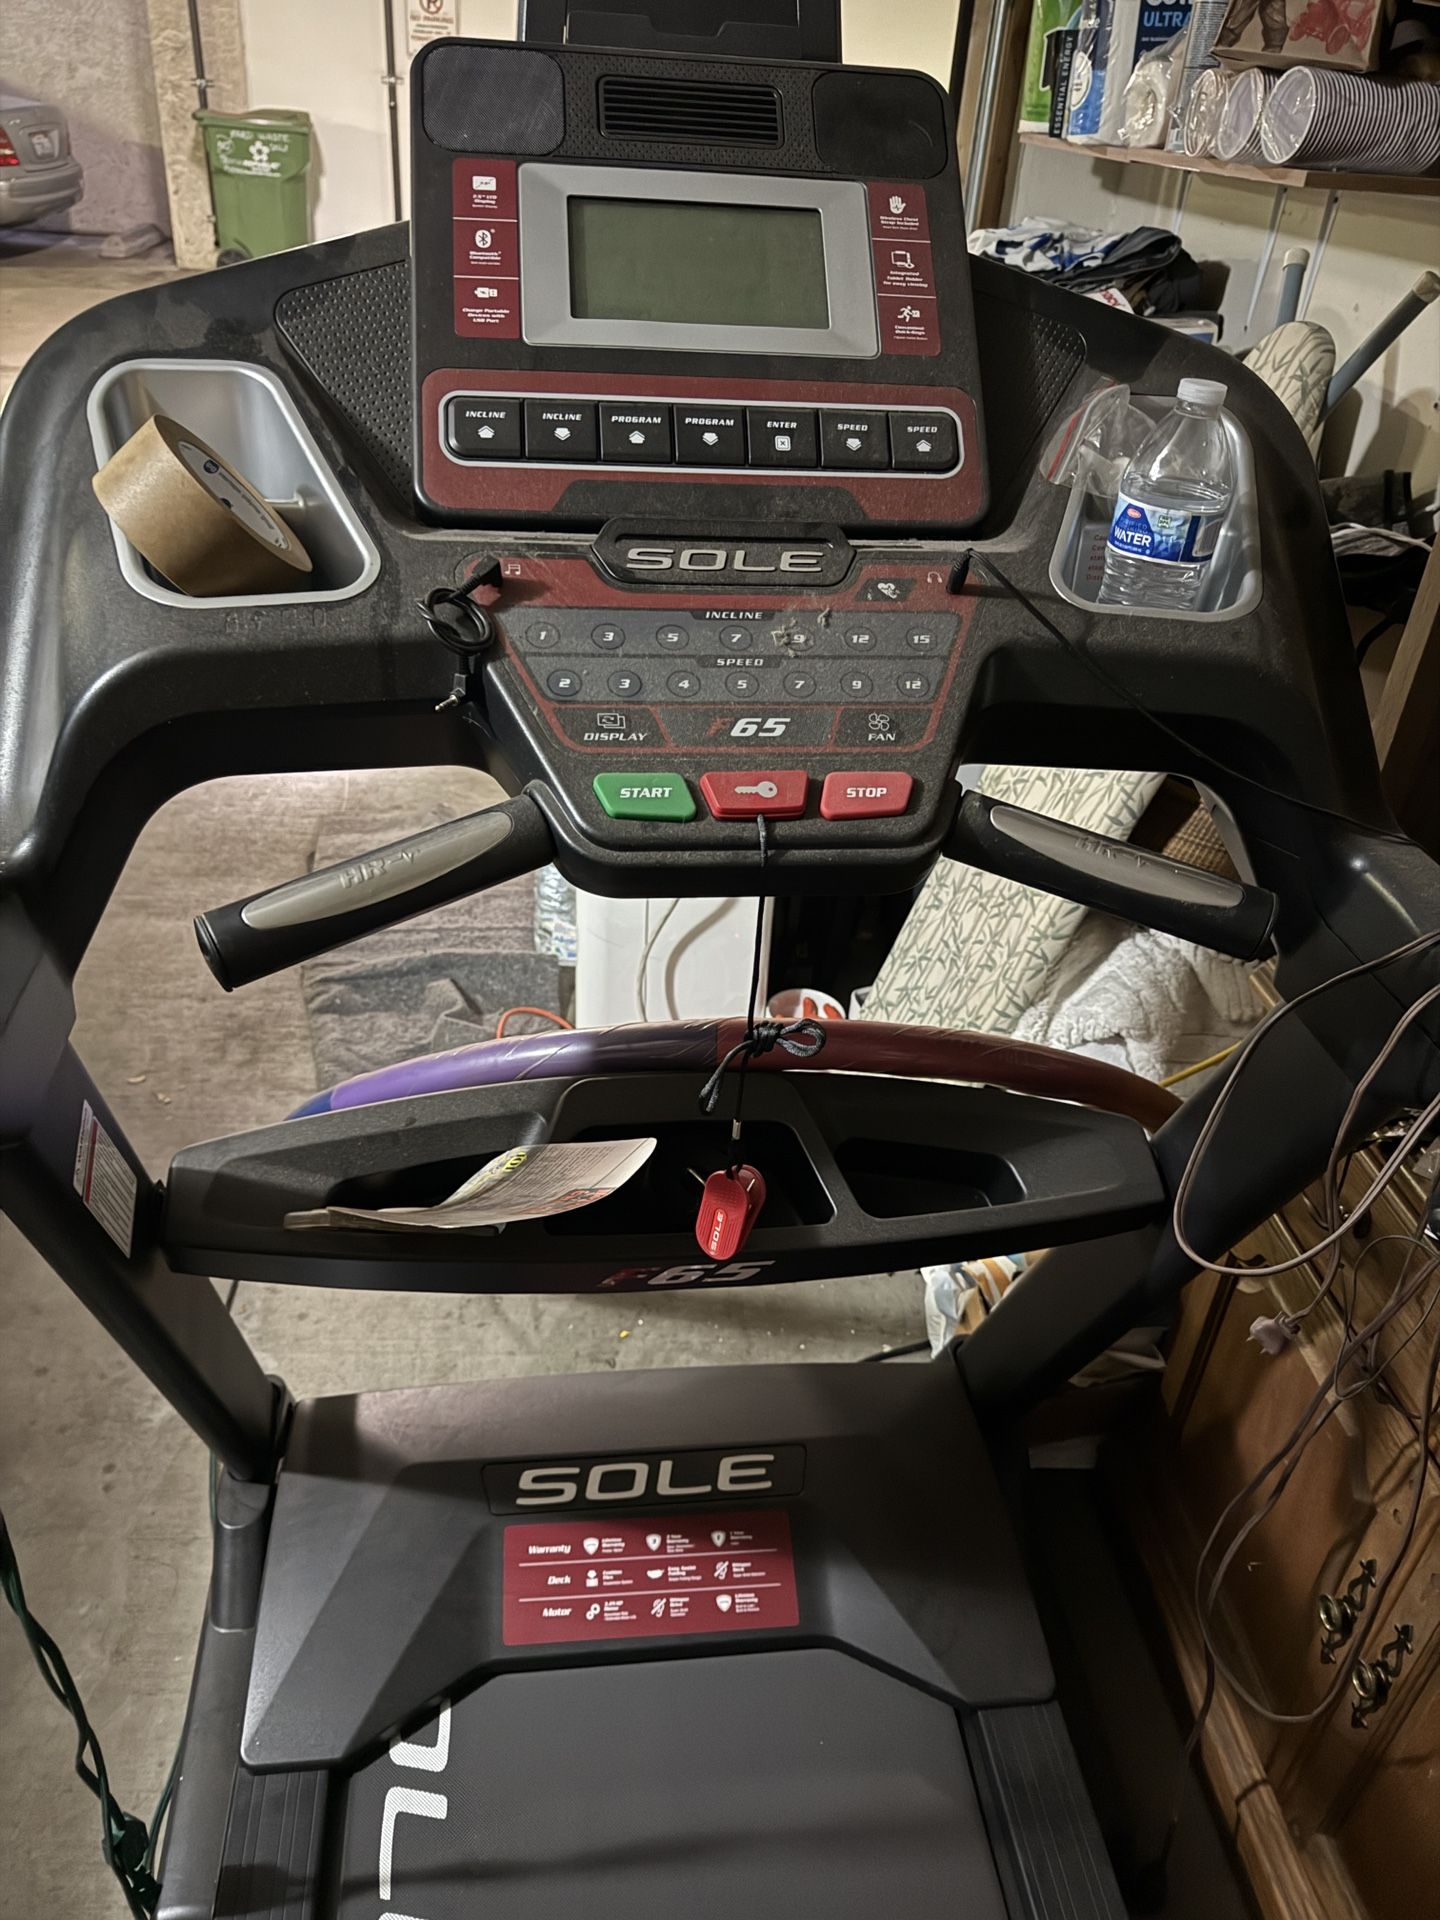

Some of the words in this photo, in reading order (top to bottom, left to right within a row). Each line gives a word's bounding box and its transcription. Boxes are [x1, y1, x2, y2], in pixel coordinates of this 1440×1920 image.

[1053, 80, 1068, 135] ESSENTIAL
[1061, 36, 1074, 77] ENERGY
[465, 410, 506, 419] INCLINE
[542, 412, 582, 421] INCLINE
[611, 415, 662, 424] PROGRAM
[685, 417, 735, 427] PROGRAM
[766, 421, 797, 429] ENTER
[837, 423, 868, 432] SPEED
[907, 425, 938, 433] SPEED
[1114, 526, 1152, 547] WATER
[626, 547, 824, 573] SOLE
[705, 611, 763, 620] INCLINE
[539, 631, 547, 640] 1
[602, 632, 615, 641] 3
[666, 632, 679, 642] 5
[730, 633, 742, 643] 7
[793, 634, 806, 643] 9
[852, 634, 870, 644] 12
[912, 634, 931, 644] 15
[716, 658, 764, 667] SPEED
[558, 678, 571, 688] 2
[618, 679, 631, 688] 3
[678, 679, 690, 688] 4
[736, 680, 748, 689] 5
[794, 680, 805, 689] 7
[852, 680, 862, 689] 9
[905, 680, 922, 689] 12
[705, 717, 791, 738] F65
[584, 732, 648, 742] DISPLAY
[868, 733, 896, 742] FAN
[620, 786, 673, 799] START
[846, 787, 887, 798] STOP
[340, 857, 388, 889] HR
[709, 1211, 725, 1252] SOLE
[598, 1260, 776, 1287] F65
[515, 1454, 775, 1506] SOLE
[528, 1544, 571, 1555] Warranty
[547, 1574, 571, 1585] Deck
[542, 1607, 572, 1617] Motor
